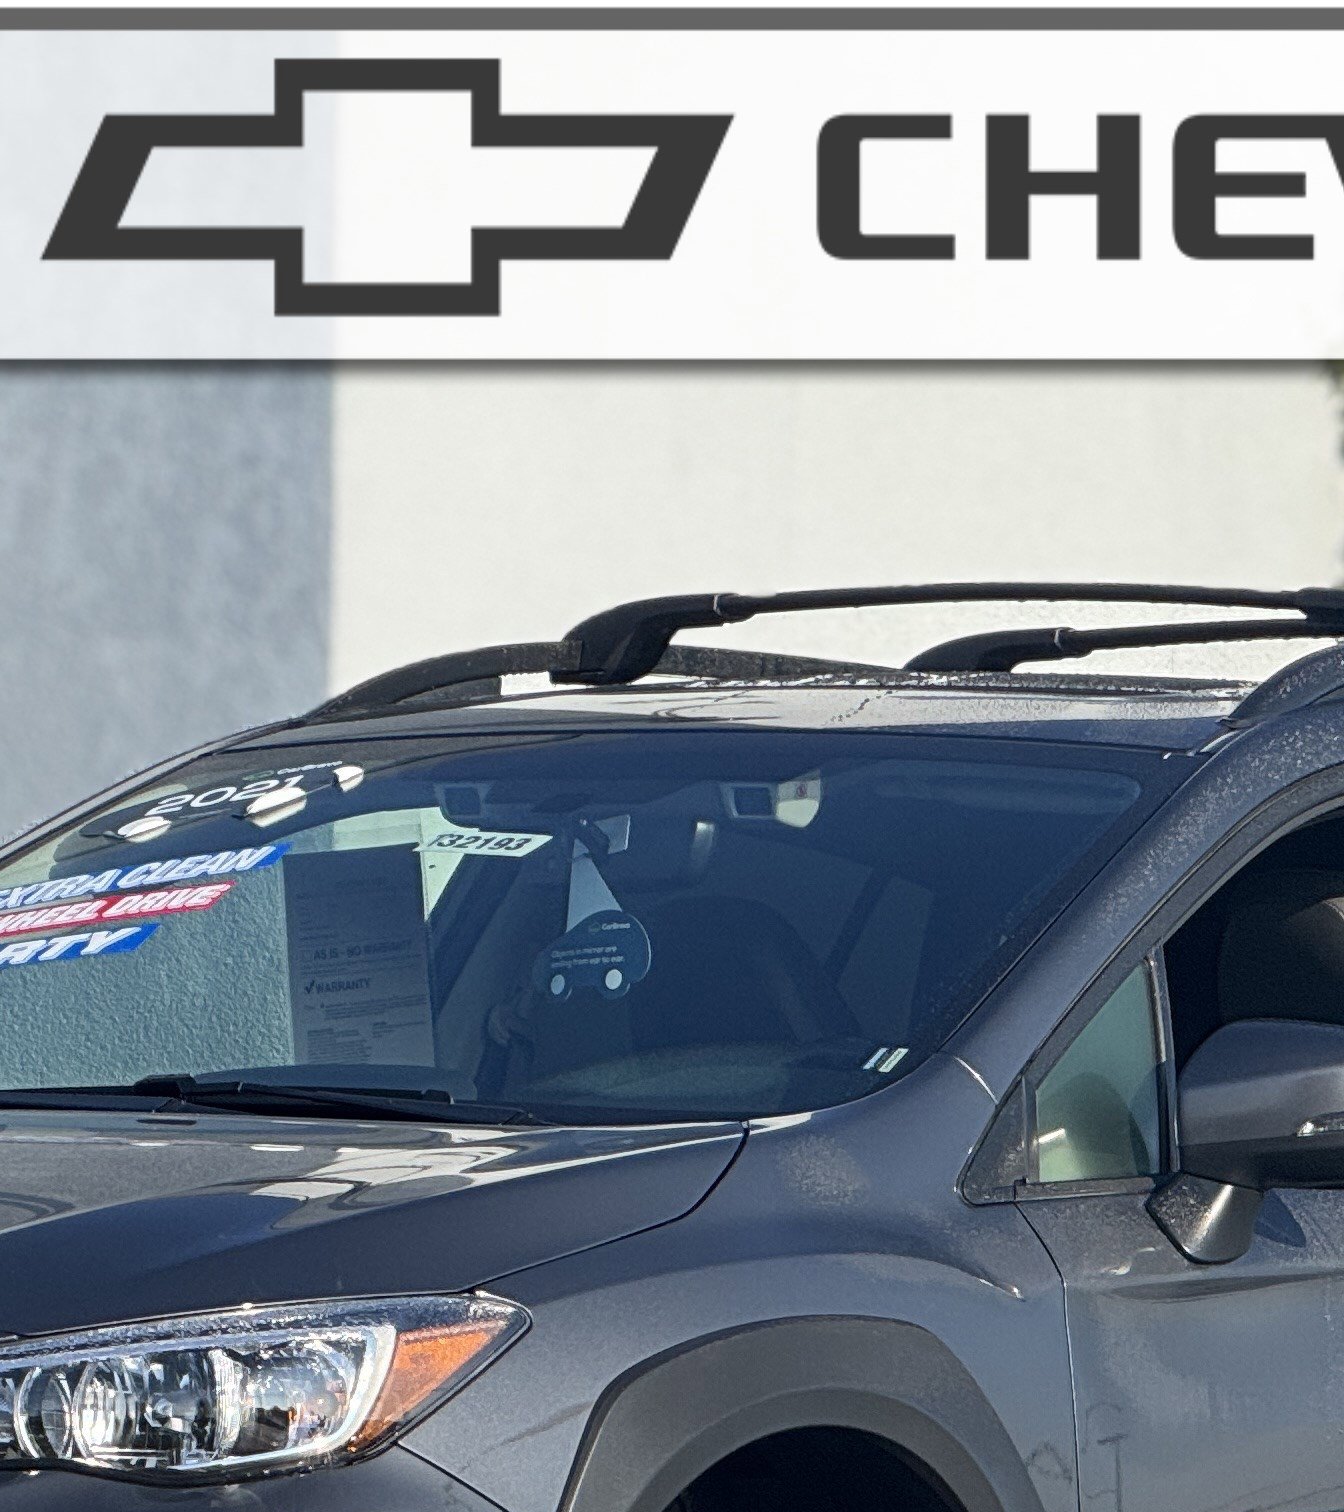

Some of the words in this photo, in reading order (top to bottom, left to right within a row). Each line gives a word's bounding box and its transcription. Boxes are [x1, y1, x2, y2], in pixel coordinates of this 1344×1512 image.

[145, 774, 304, 817] 2021
[117, 845, 276, 887] CLEAN
[102, 882, 232, 918] DRIVE
